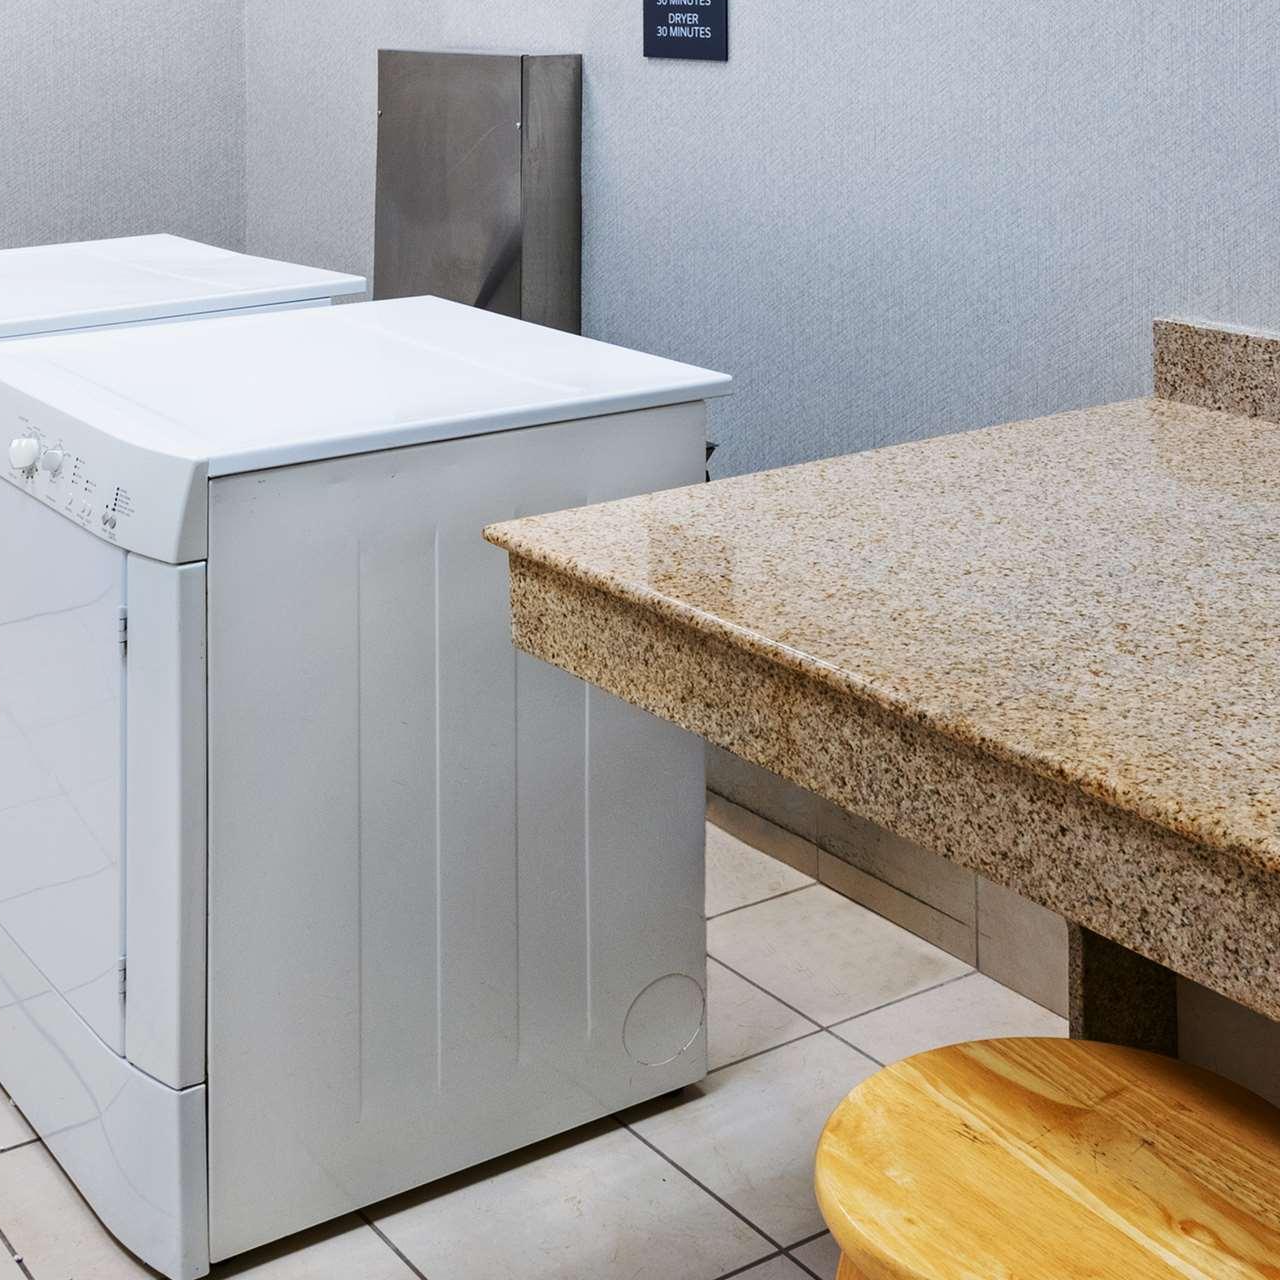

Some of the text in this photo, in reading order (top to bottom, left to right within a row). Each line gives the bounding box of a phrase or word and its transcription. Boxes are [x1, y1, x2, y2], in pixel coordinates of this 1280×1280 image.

[668, 13, 699, 24] DRYER
[656, 26, 711, 38] 30 MINUTES
